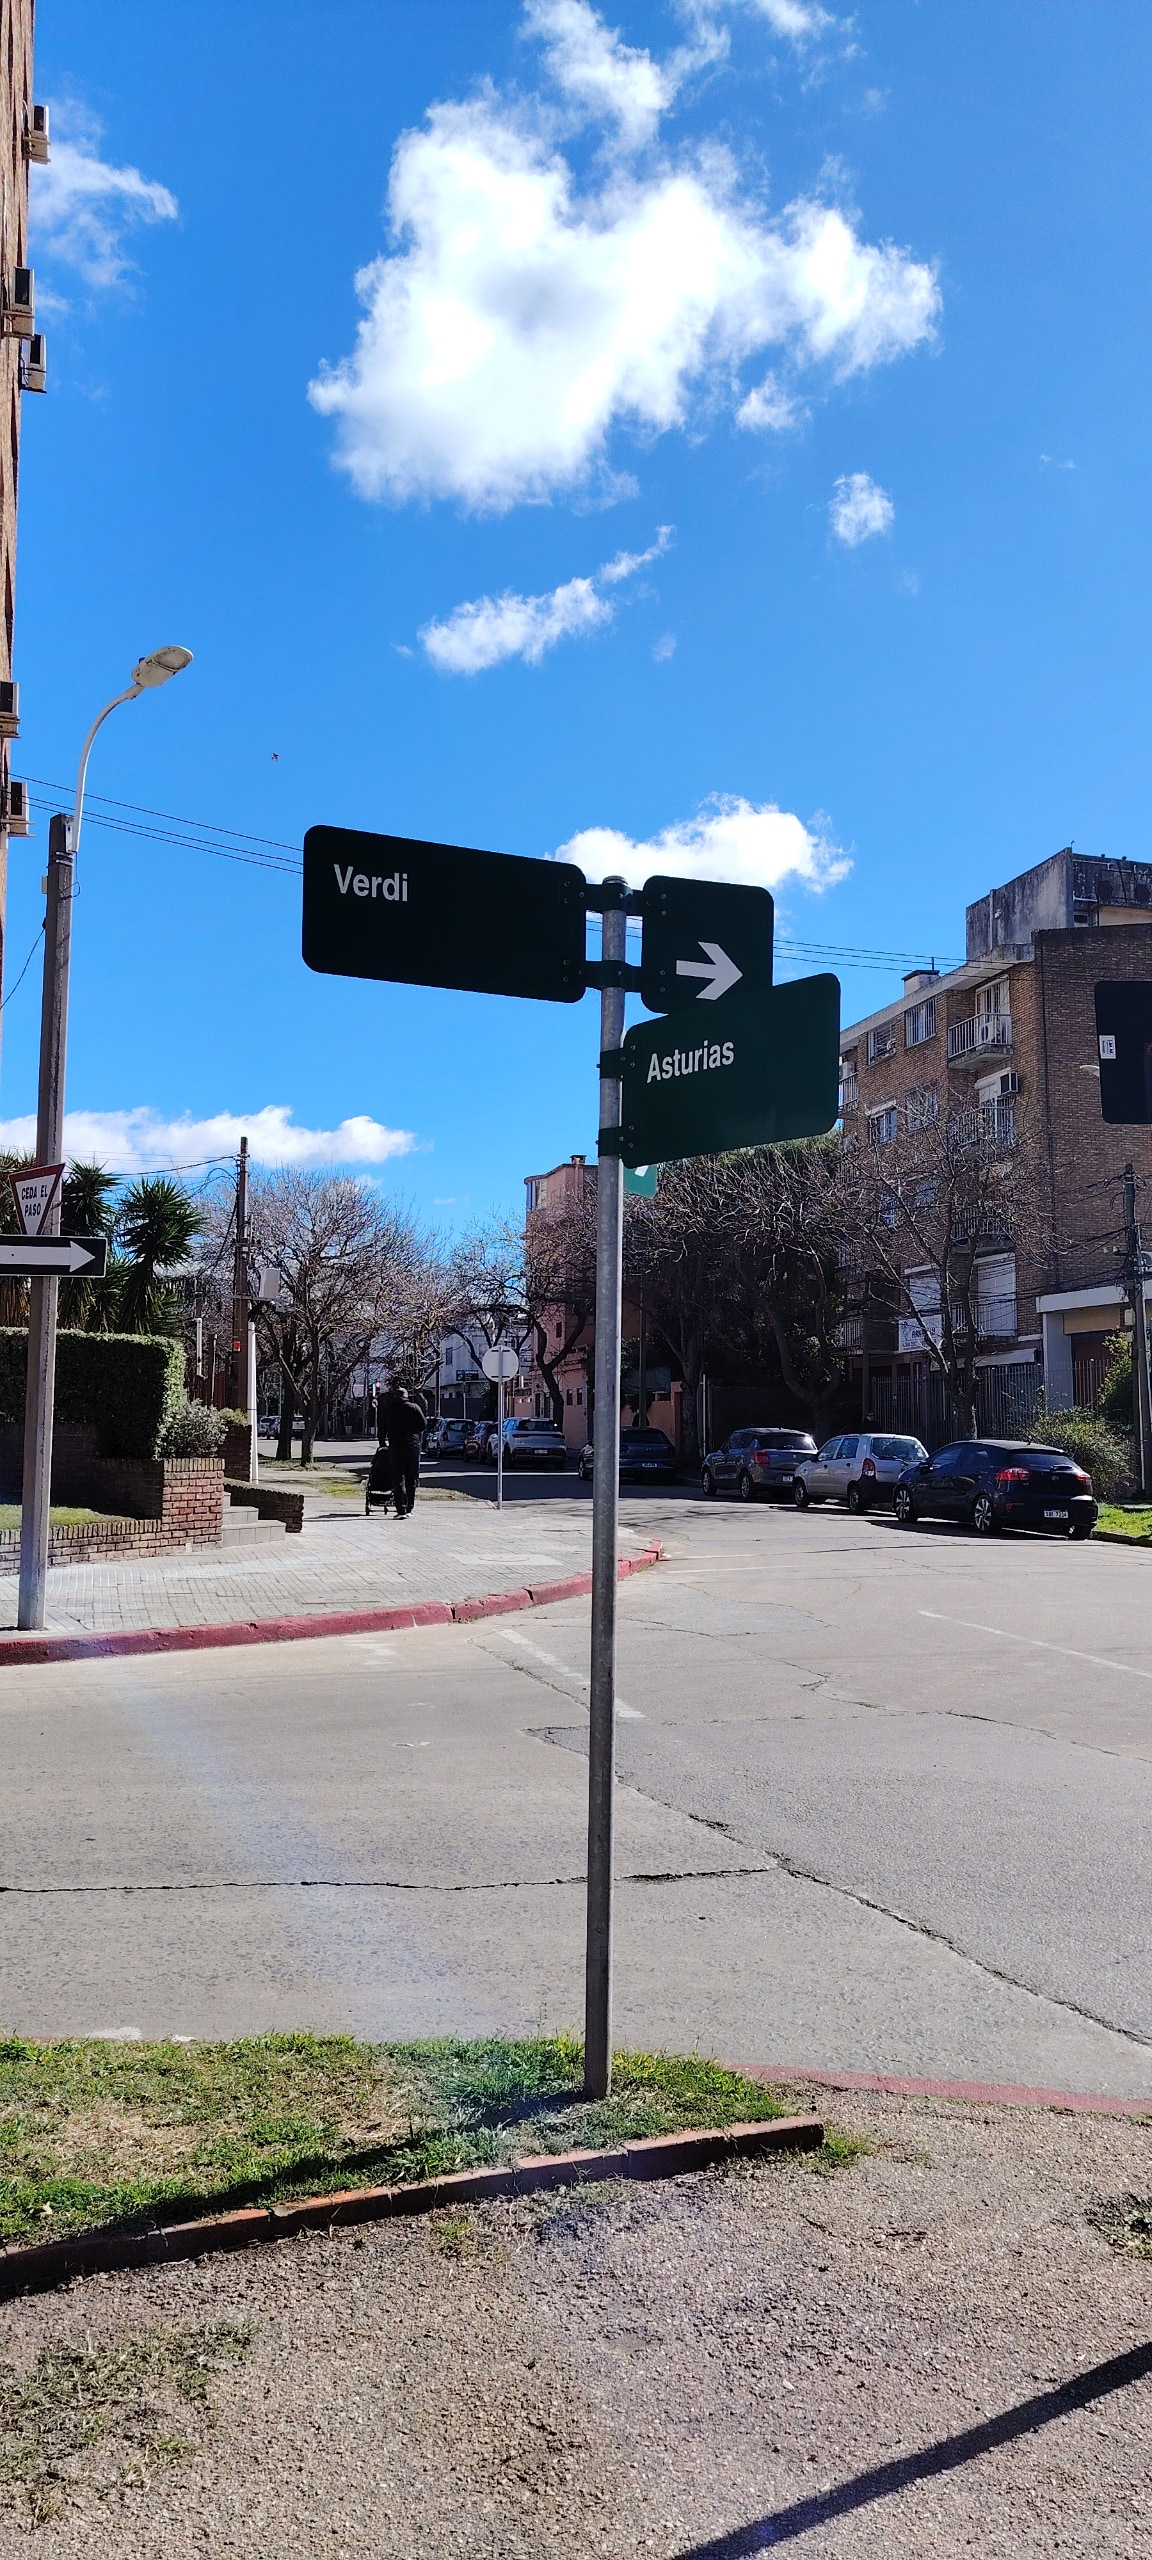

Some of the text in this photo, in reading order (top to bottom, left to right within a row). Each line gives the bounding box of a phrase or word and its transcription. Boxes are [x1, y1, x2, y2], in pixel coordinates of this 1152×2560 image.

[333, 864, 408, 902] Verdi
[646, 1040, 734, 1084] Asturias
[21, 1185, 48, 1200] CEDA EL
[24, 1203, 42, 1217] PASO
